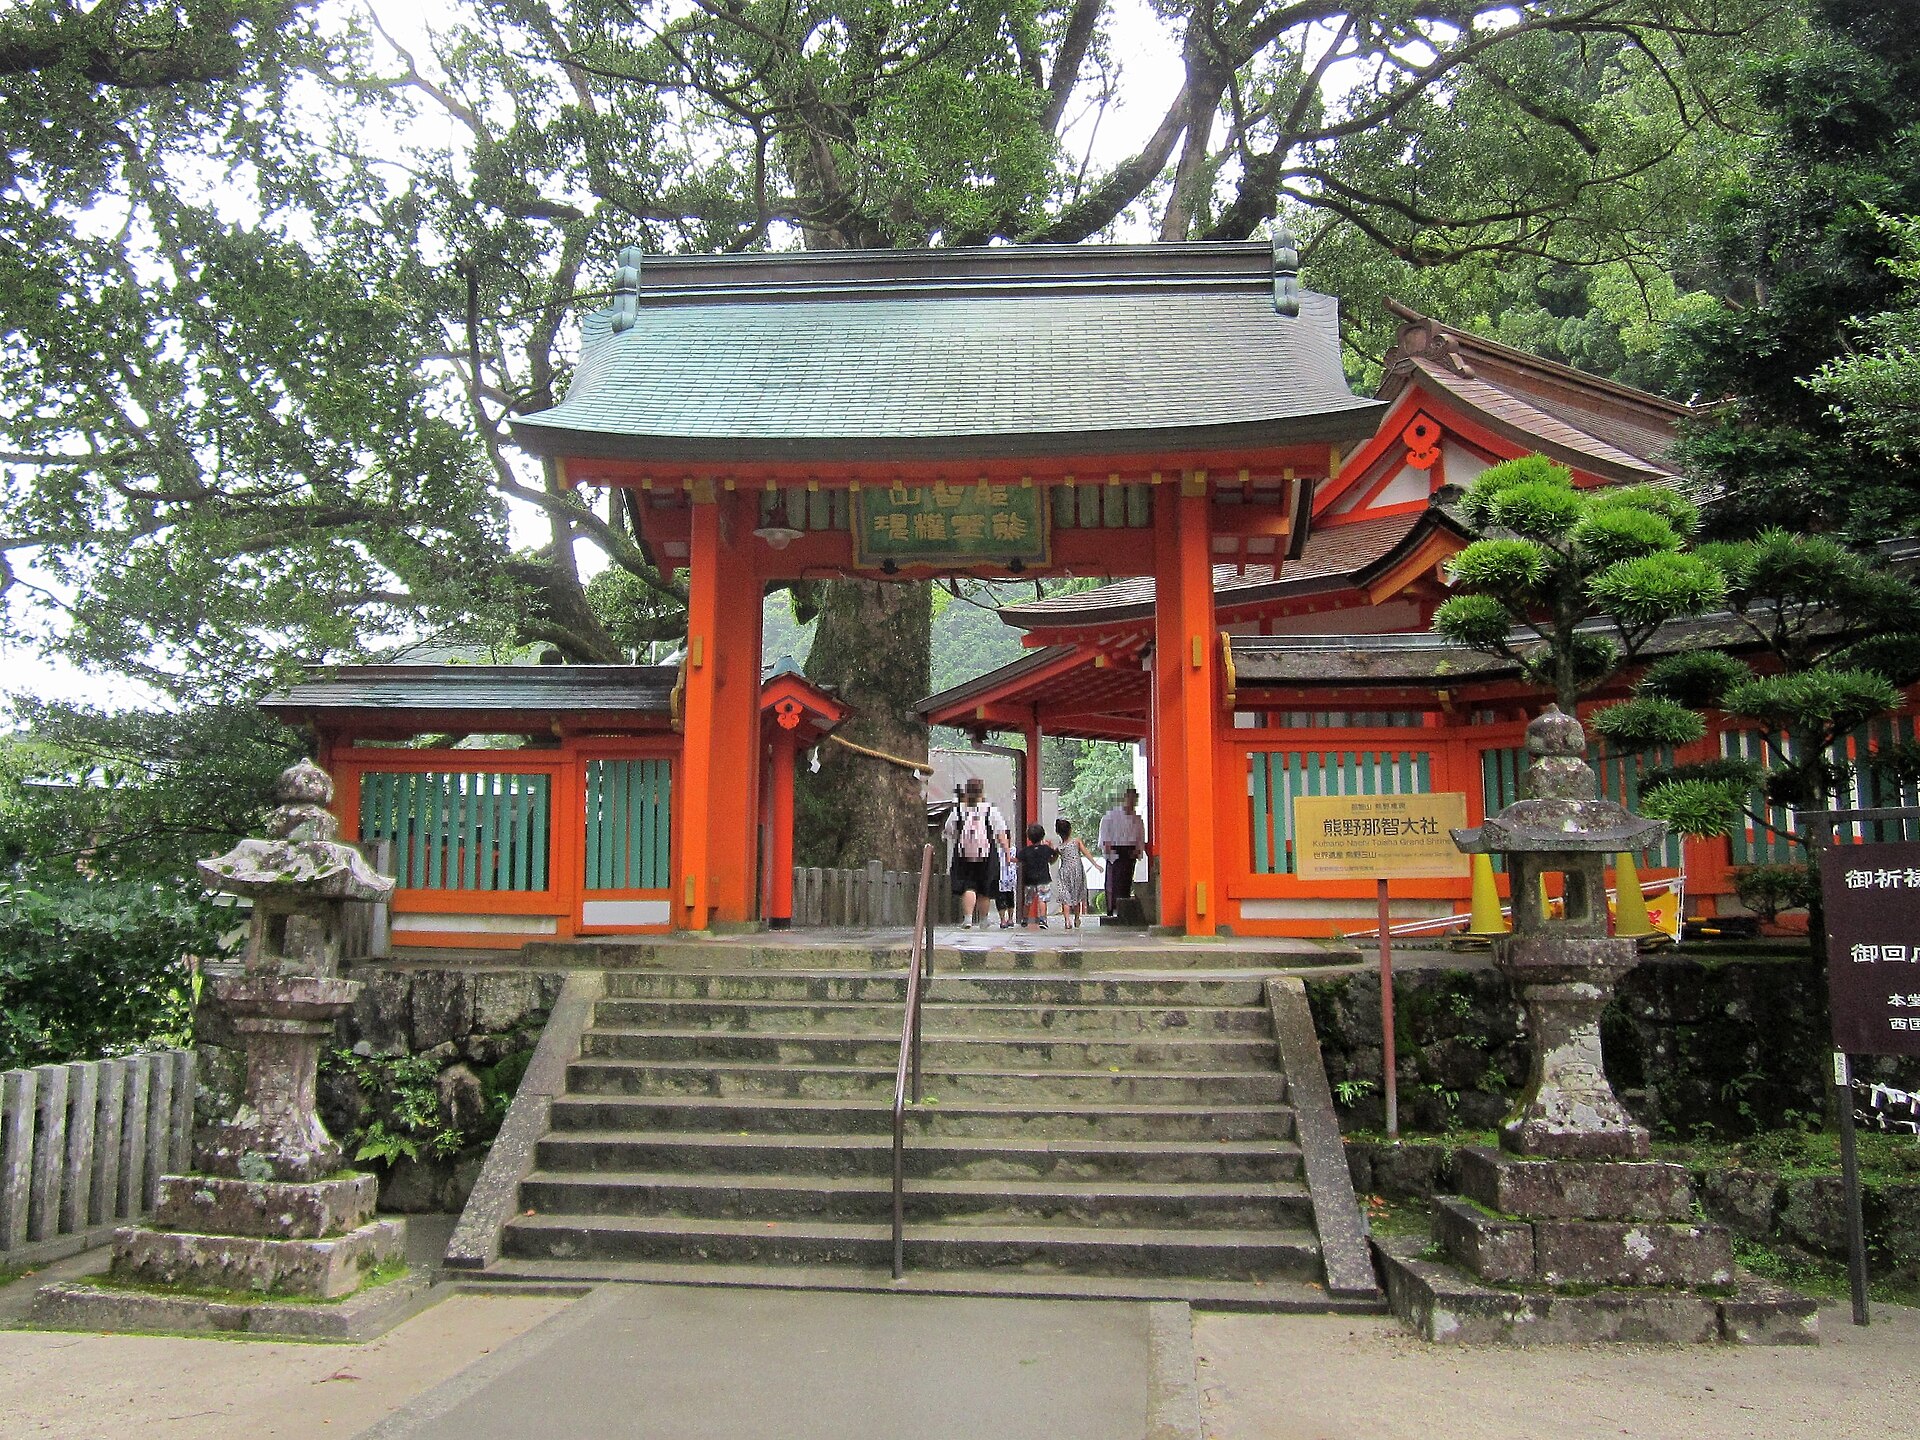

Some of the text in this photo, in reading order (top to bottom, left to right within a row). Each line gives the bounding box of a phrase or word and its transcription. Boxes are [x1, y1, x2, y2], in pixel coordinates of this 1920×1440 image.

[1323, 817, 1439, 837] 熊野那智大社
[1312, 840, 1345, 848] Kumano
